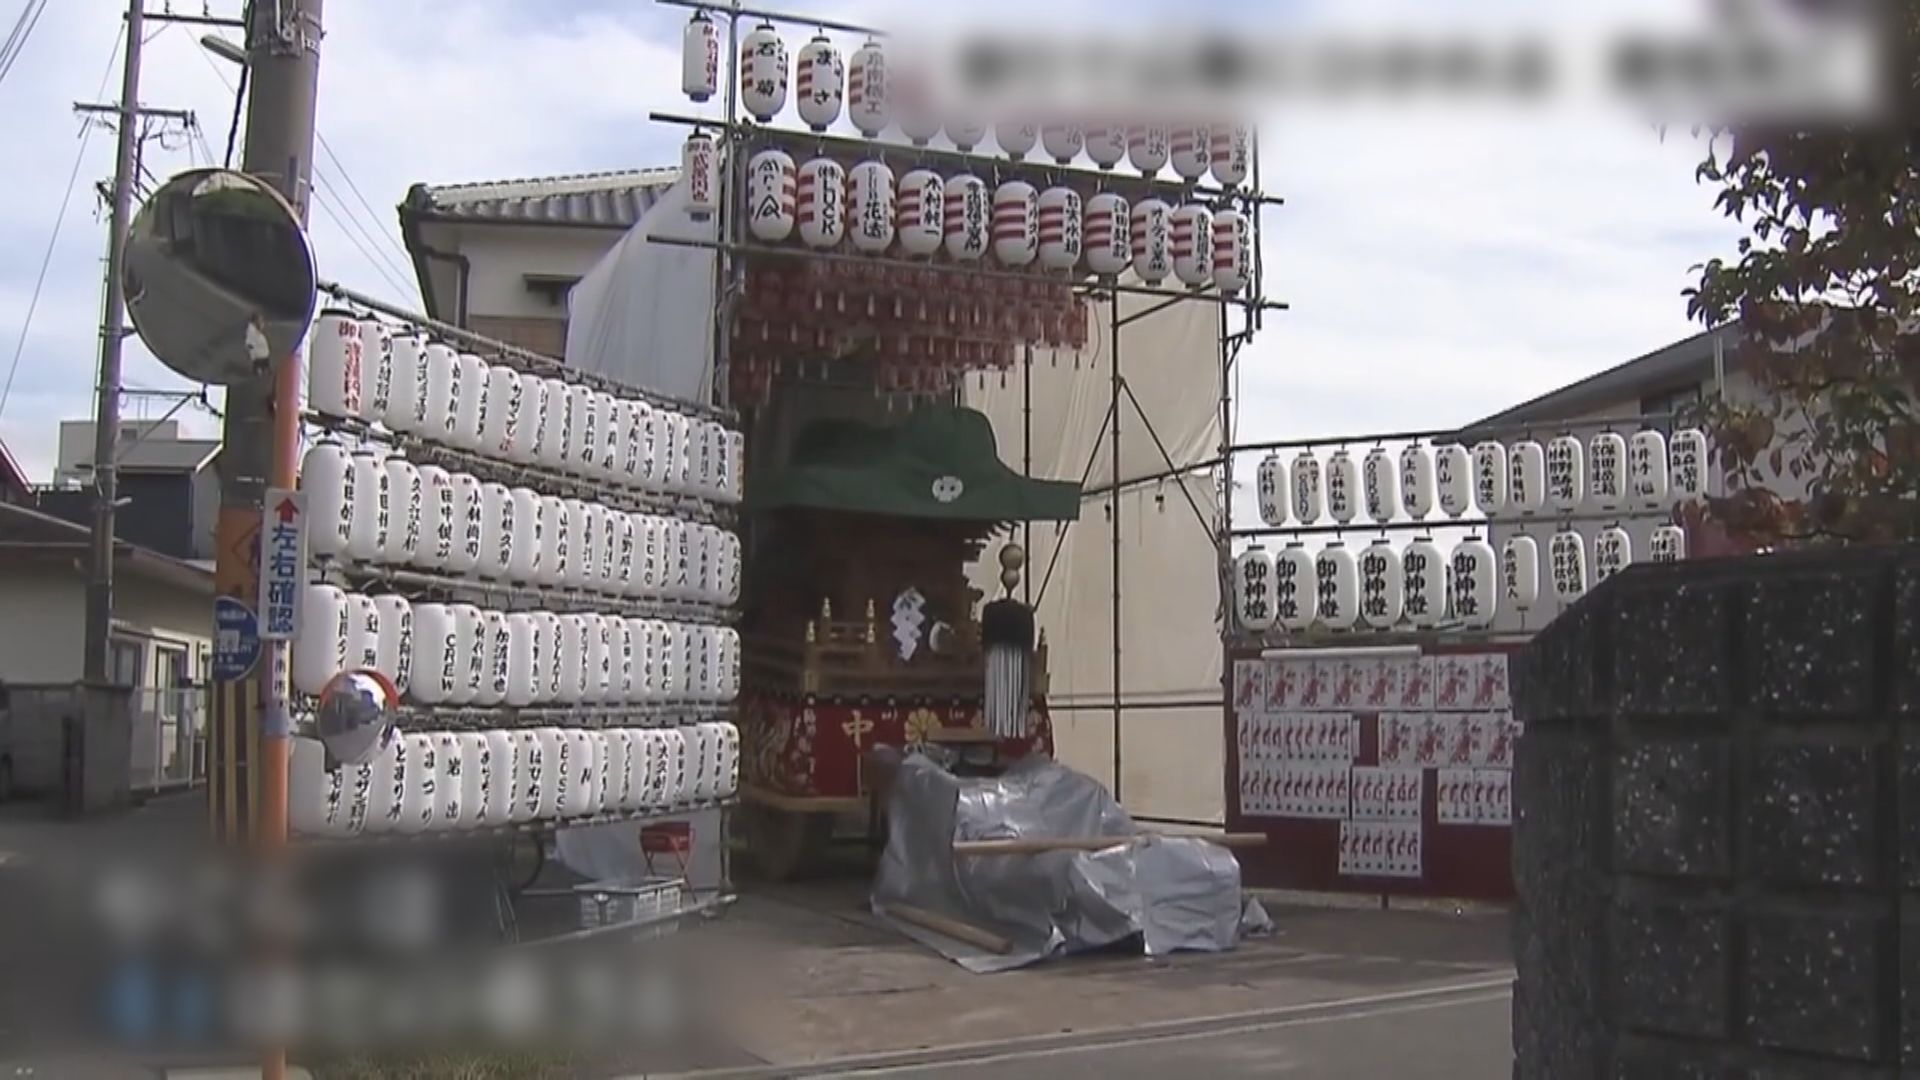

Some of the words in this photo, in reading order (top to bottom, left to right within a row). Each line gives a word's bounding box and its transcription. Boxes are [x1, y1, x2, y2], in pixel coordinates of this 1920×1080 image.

[269, 524, 298, 633] 左右確認
[842, 710, 874, 748] 中
